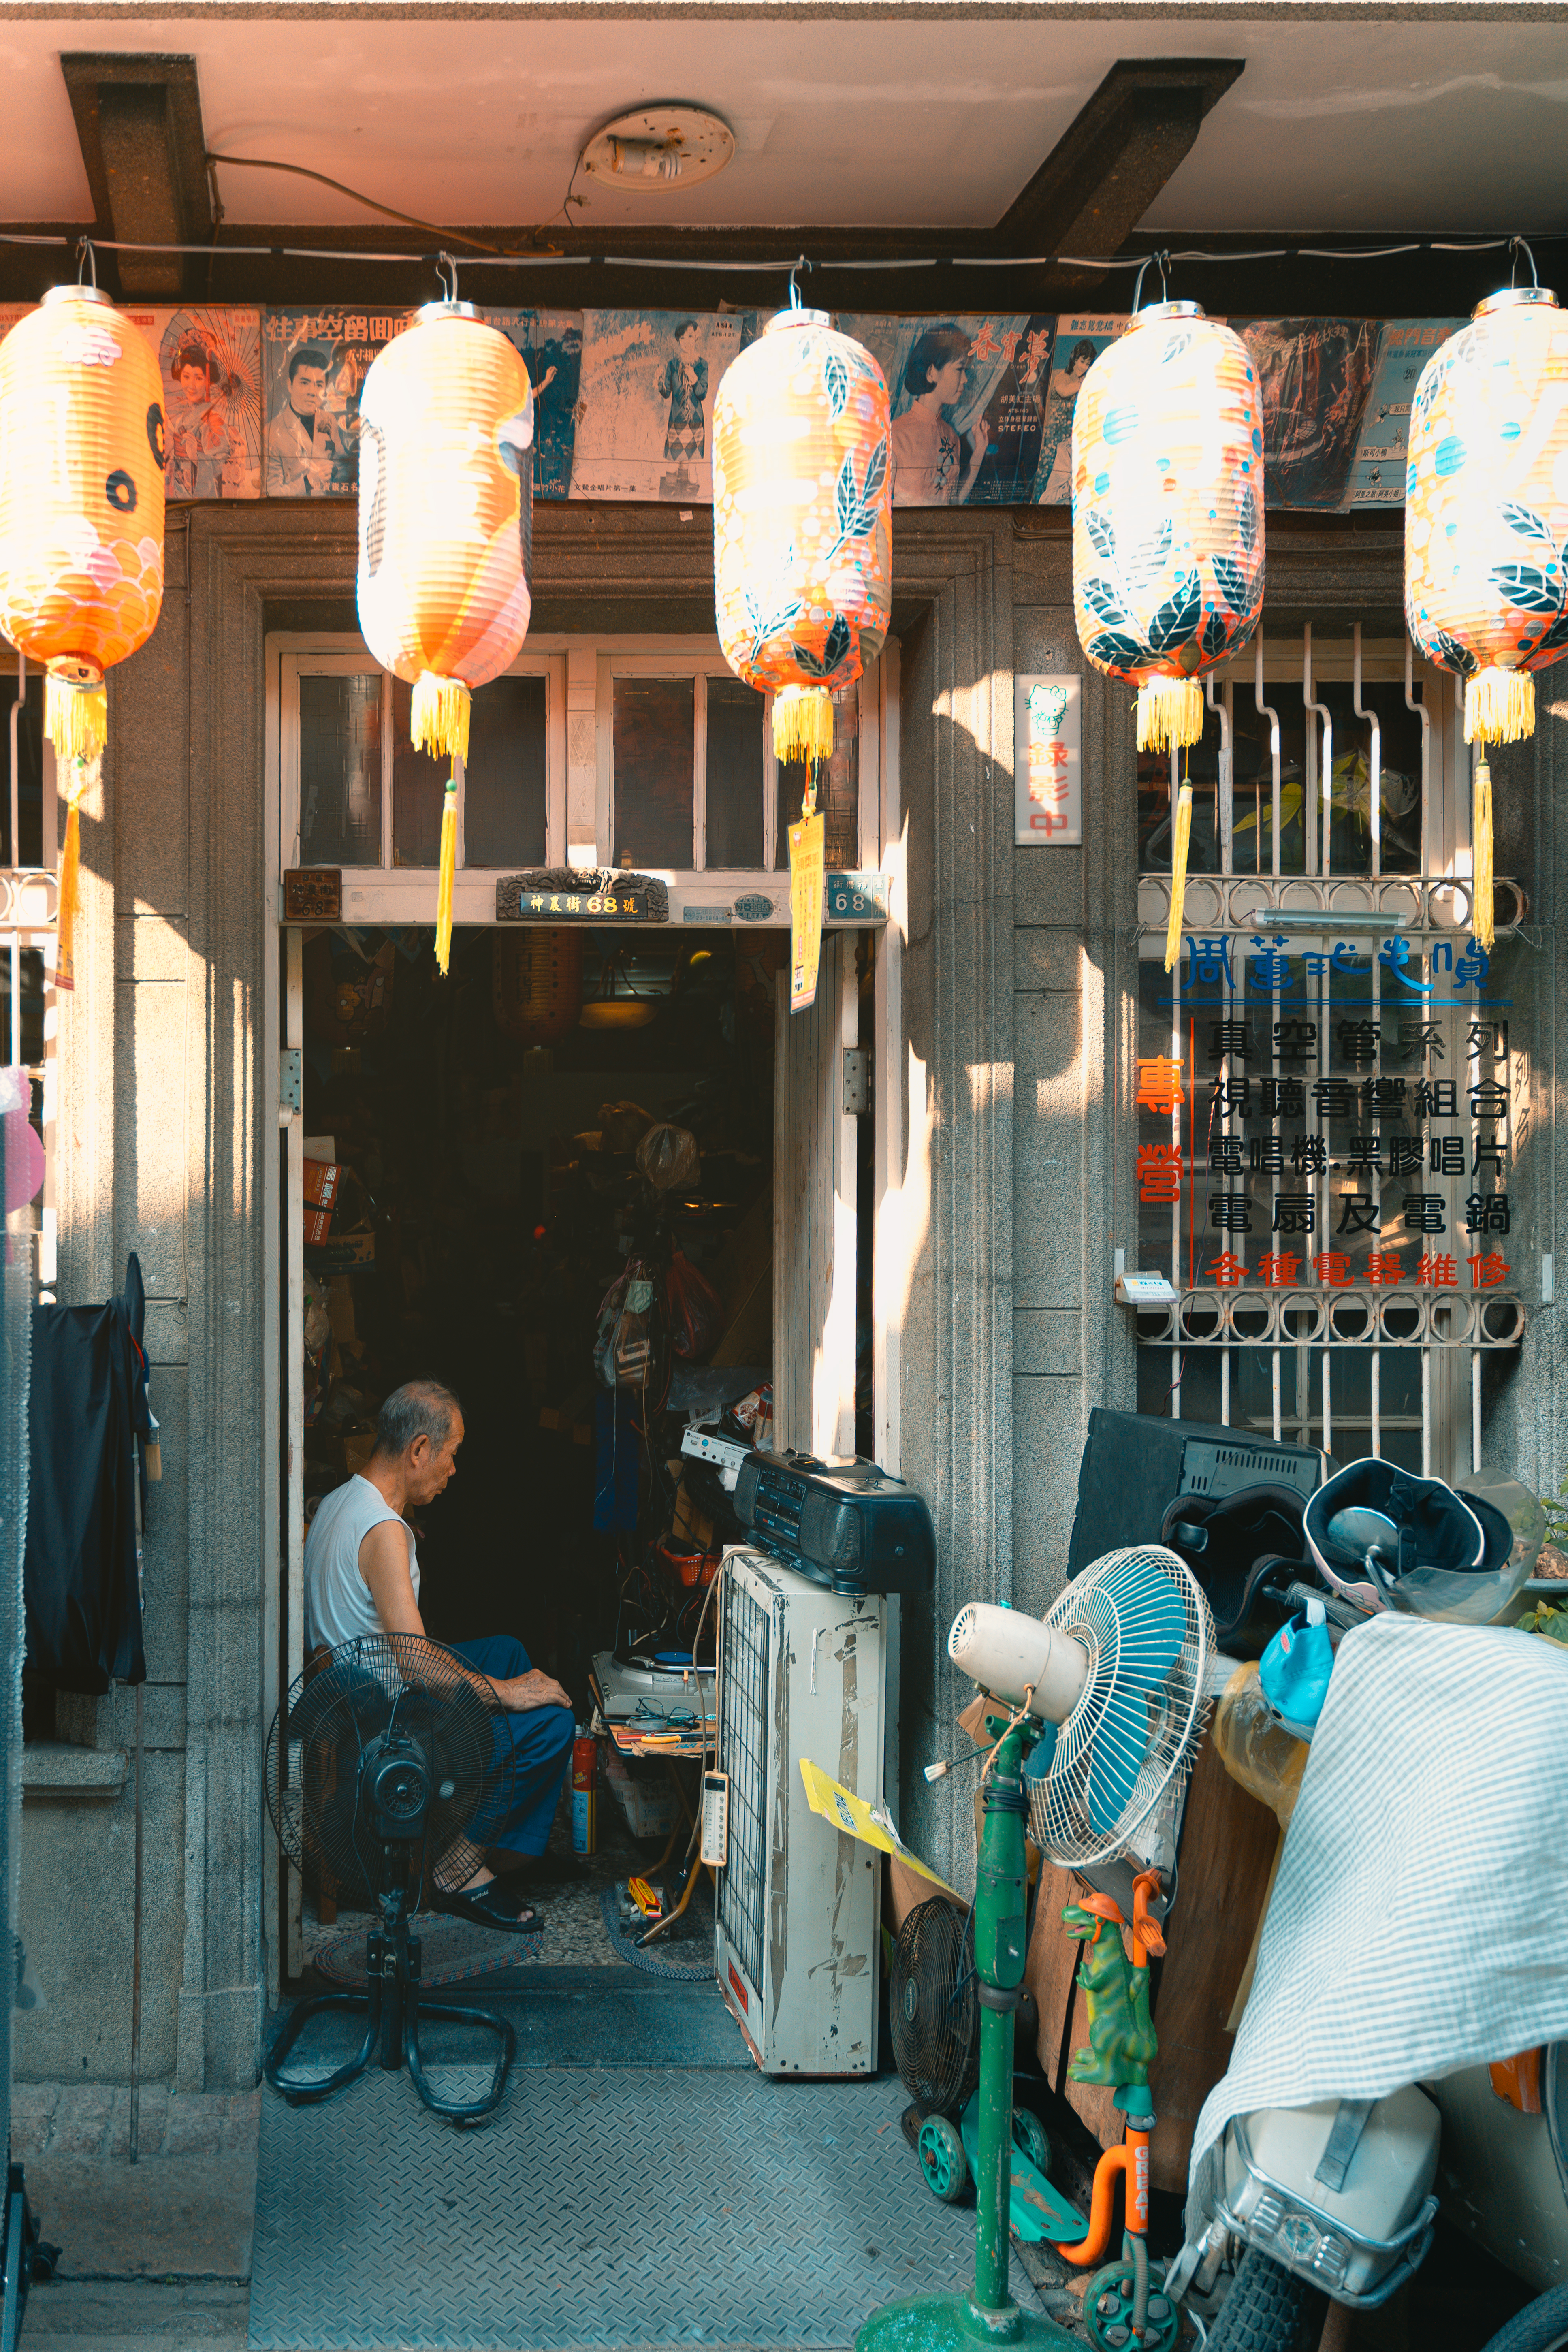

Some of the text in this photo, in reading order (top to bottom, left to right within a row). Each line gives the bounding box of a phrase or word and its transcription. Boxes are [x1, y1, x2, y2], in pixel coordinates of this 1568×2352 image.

[968, 322, 1050, 384] 春宵夢
[1404, 368, 1416, 380] 20
[1028, 741, 1070, 837] 錄影中
[301, 901, 324, 916] 68
[530, 894, 638, 914] 神農街68號
[836, 893, 864, 911] 68
[1207, 1019, 1509, 1061] 真空管系列
[1207, 1077, 1511, 1120] 視聽音響組合
[1136, 1054, 1185, 1203] 專營
[1207, 1192, 1510, 1235] 電扇及電鍋
[1204, 1250, 1512, 1288] 各種電器維修
[1135, 2145, 1149, 2220] GREAT
